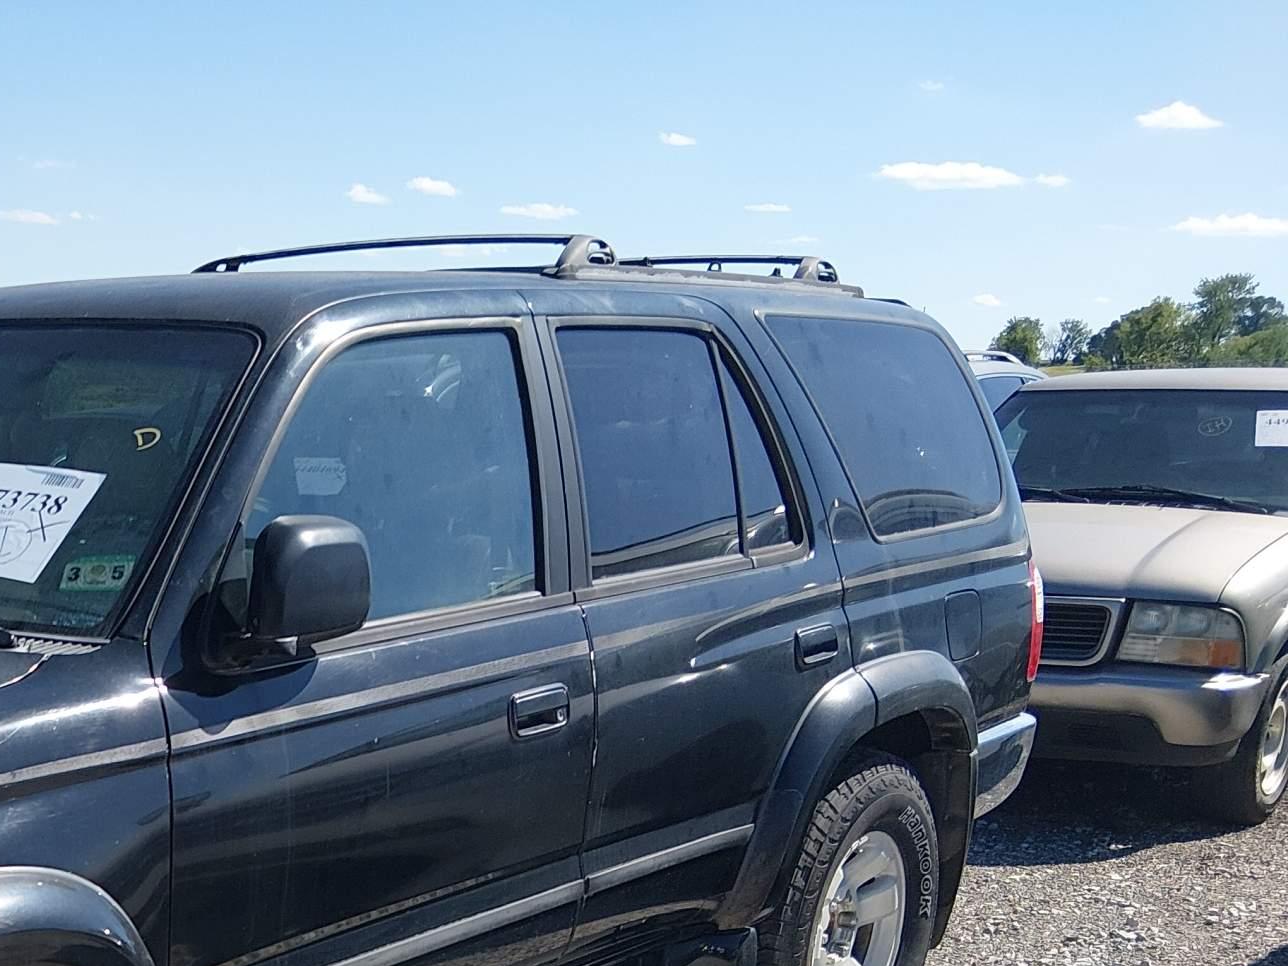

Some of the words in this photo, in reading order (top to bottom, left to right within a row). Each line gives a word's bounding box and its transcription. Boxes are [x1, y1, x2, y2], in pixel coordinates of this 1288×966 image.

[134, 427, 161, 450] D
[67, 567, 81, 582] 3
[111, 565, 126, 580] 5
